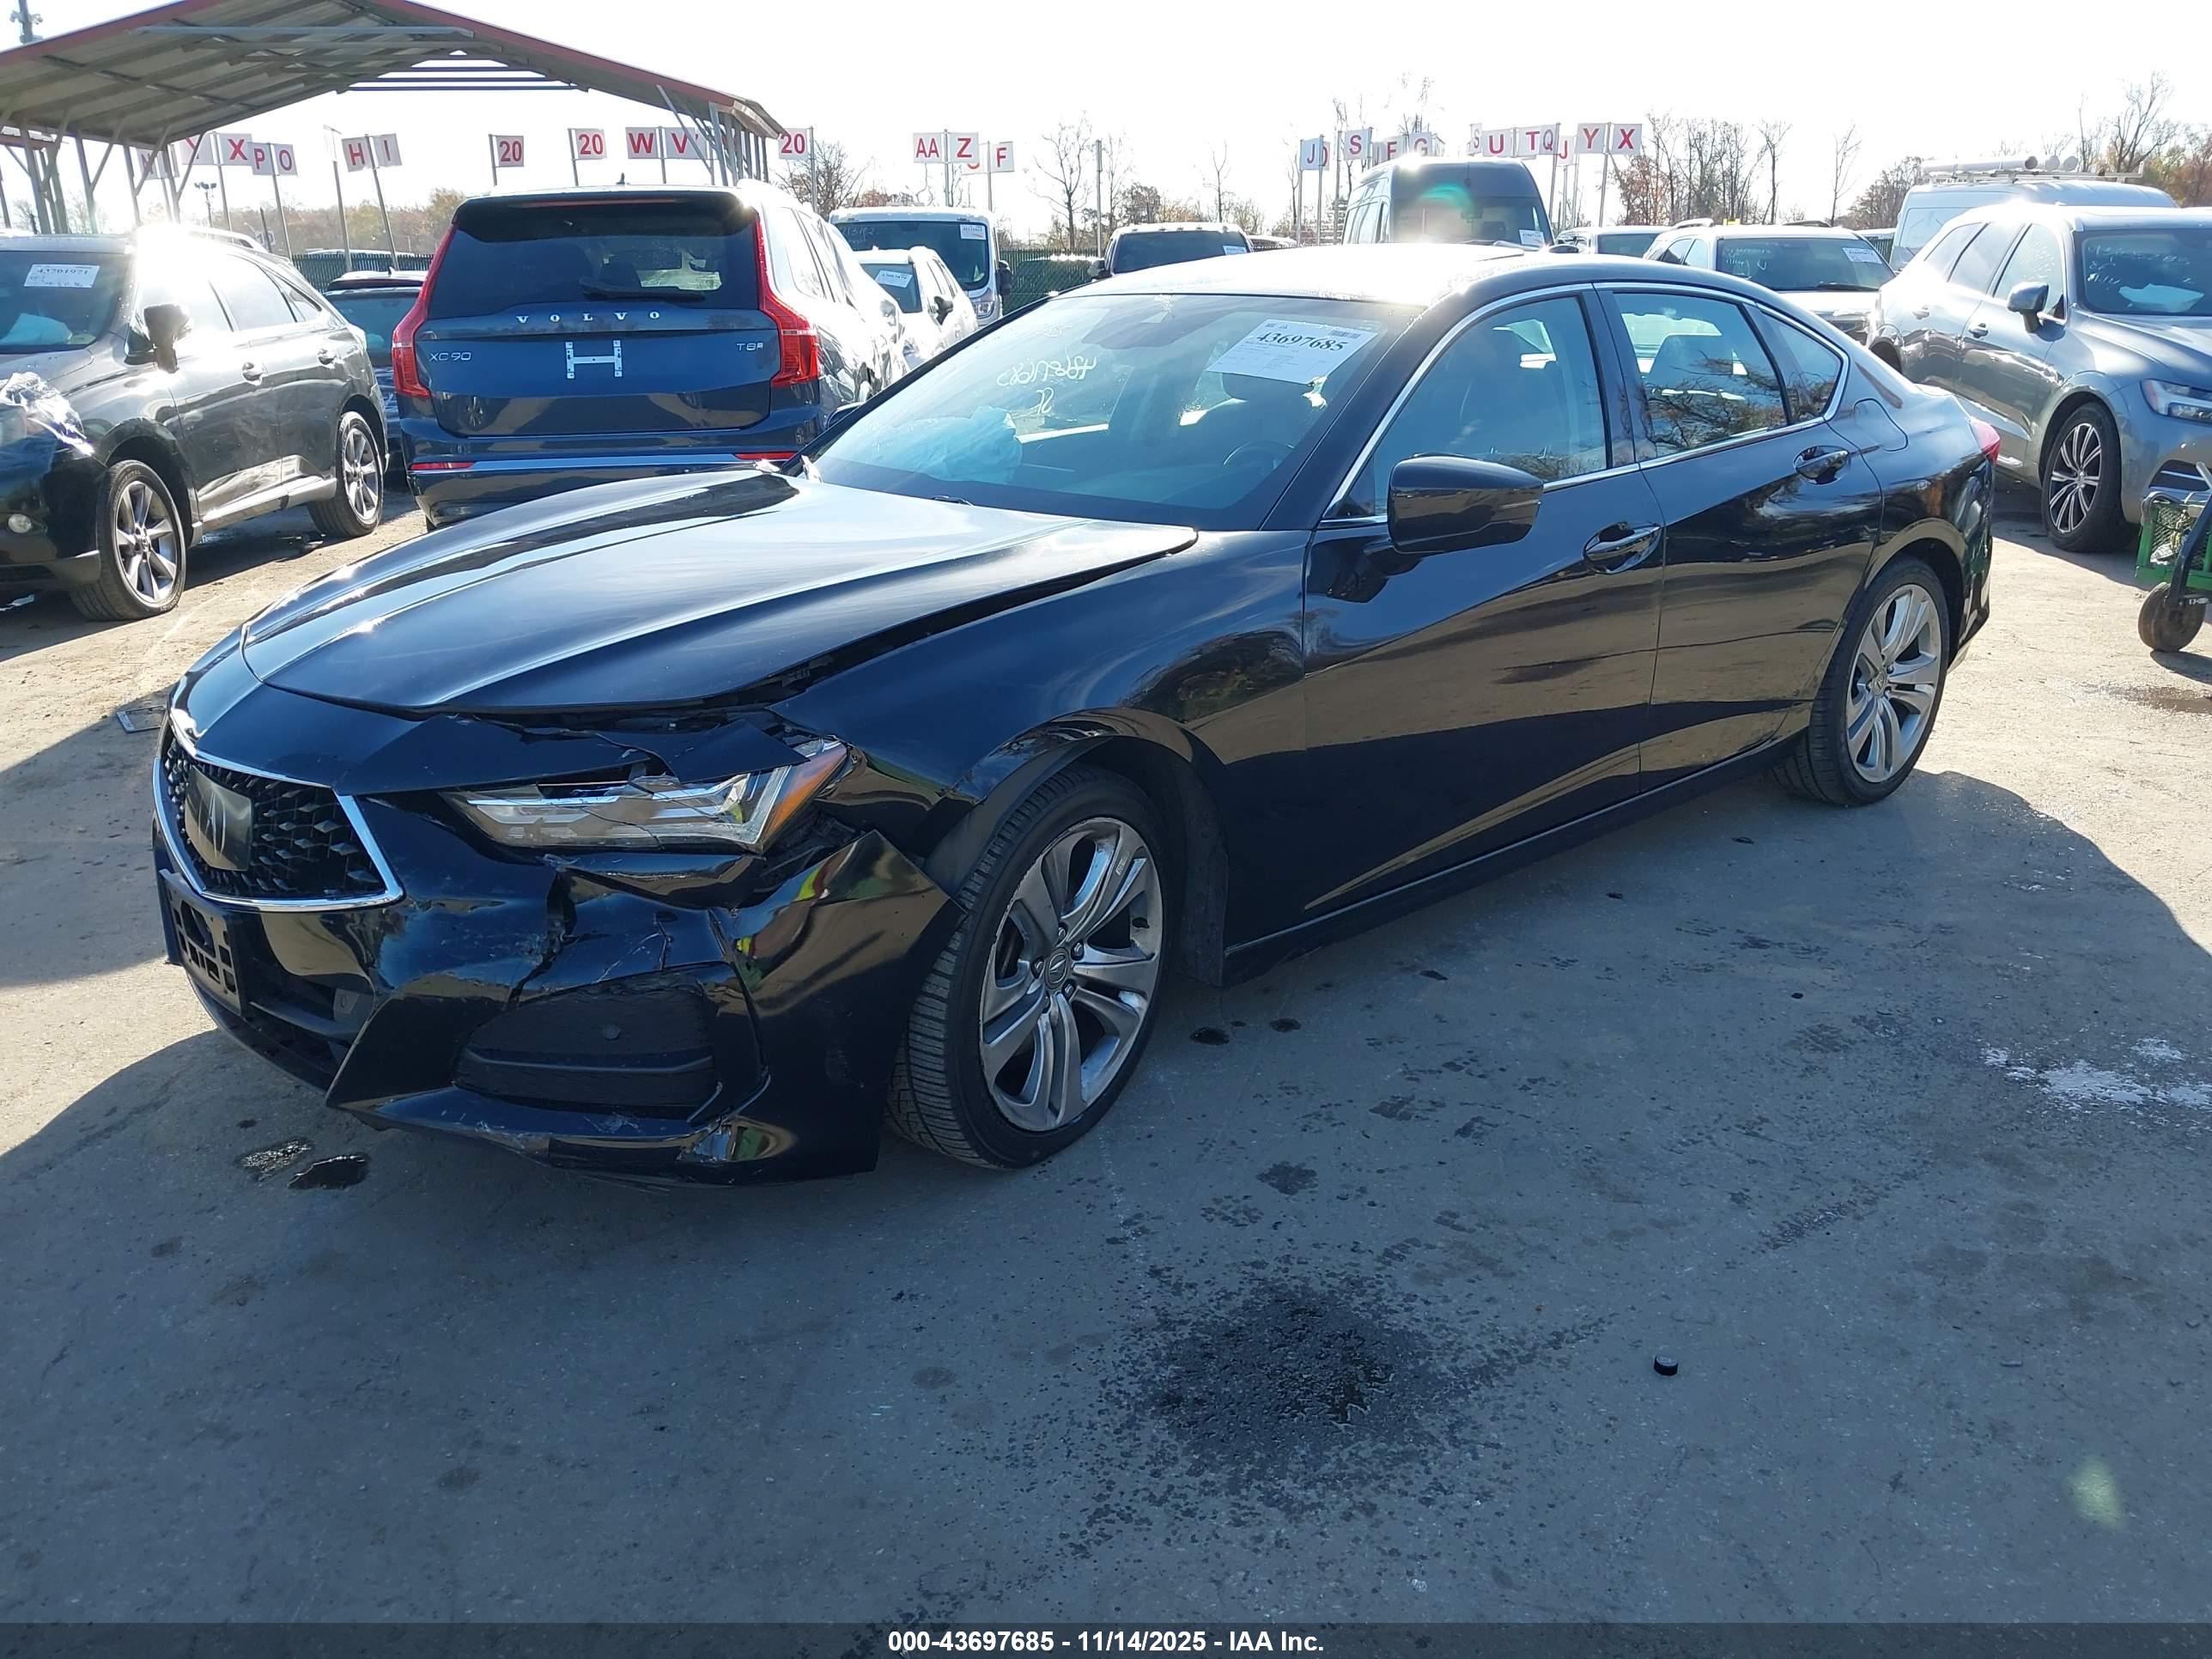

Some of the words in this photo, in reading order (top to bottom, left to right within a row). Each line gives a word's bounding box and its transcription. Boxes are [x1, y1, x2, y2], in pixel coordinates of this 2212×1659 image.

[578, 134, 604, 155] 20
[629, 132, 654, 154] W
[780, 133, 805, 154] 20
[915, 137, 940, 158] AA
[957, 137, 972, 158] Z
[1349, 134, 1362, 155] S
[1489, 134, 1504, 155] U
[1526, 131, 1540, 151] T
[1542, 129, 1553, 151] Q
[1583, 128, 1600, 149] Y
[1618, 129, 1636, 149] X
[228, 138, 248, 161] X
[253, 148, 265, 169] P
[278, 149, 293, 171] O
[348, 143, 366, 166] H
[383, 139, 392, 161] I
[499, 140, 522, 161] 20
[996, 147, 1007, 167] F
[1307, 143, 1315, 164] J
[1559, 140, 1568, 160] J
[516, 311, 660, 324] VOLVO
[1256, 331, 1348, 351] 43697685
